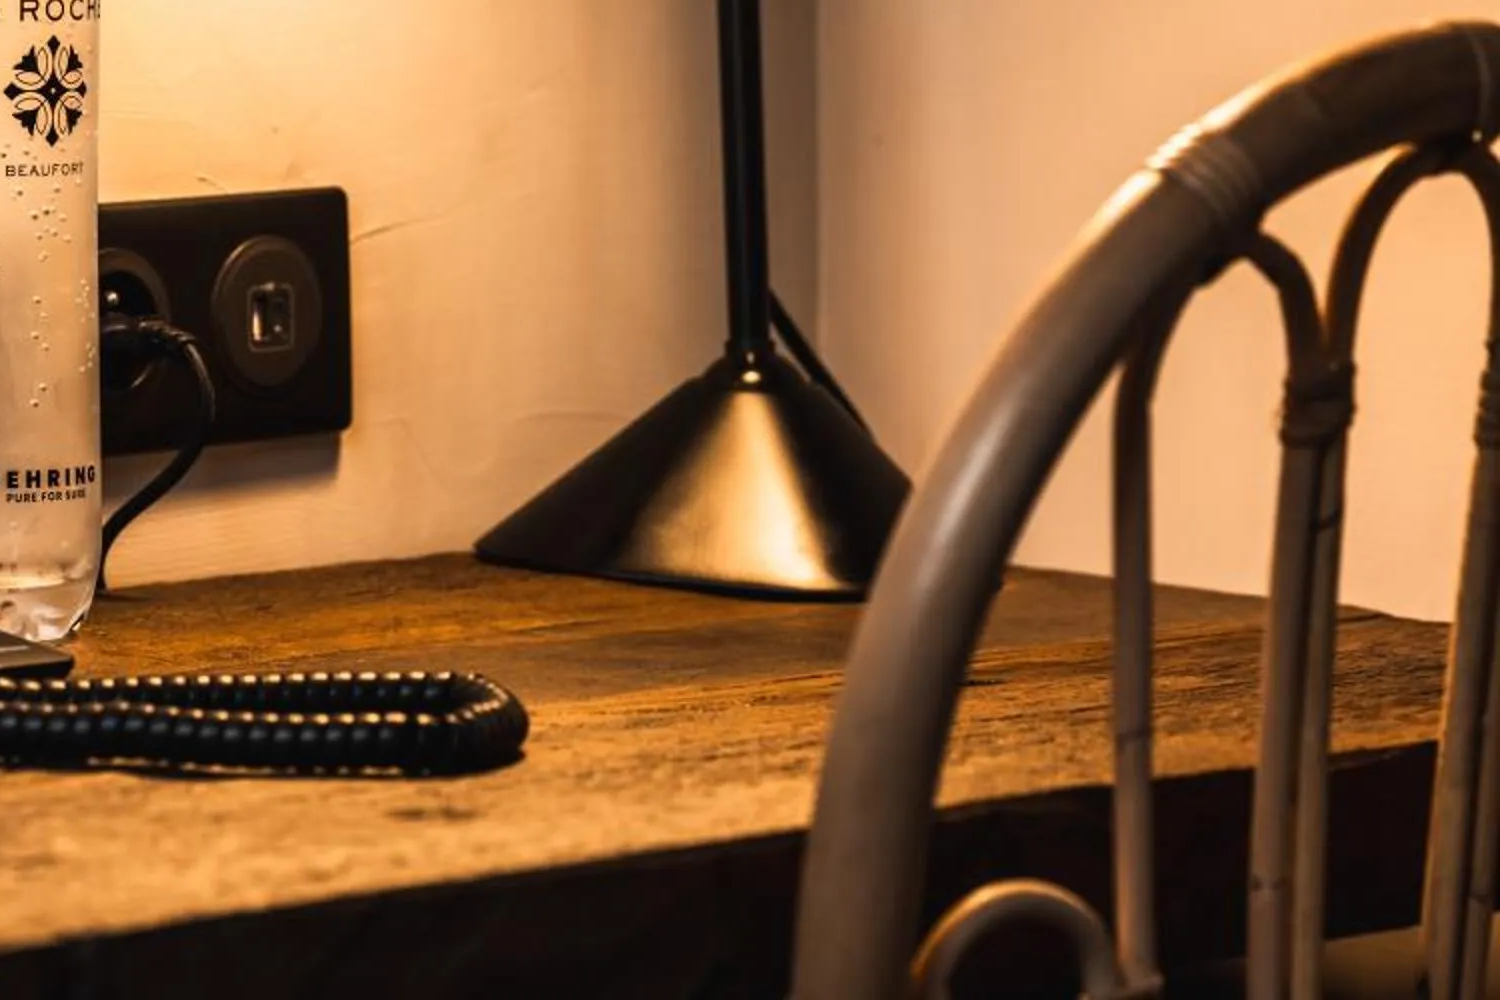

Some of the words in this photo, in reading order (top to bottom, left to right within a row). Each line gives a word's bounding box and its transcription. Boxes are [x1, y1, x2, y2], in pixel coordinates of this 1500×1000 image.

[5, 162, 84, 177] BEAUFORT
[6, 493, 37, 503] PURE
[41, 491, 63, 502] FOR
